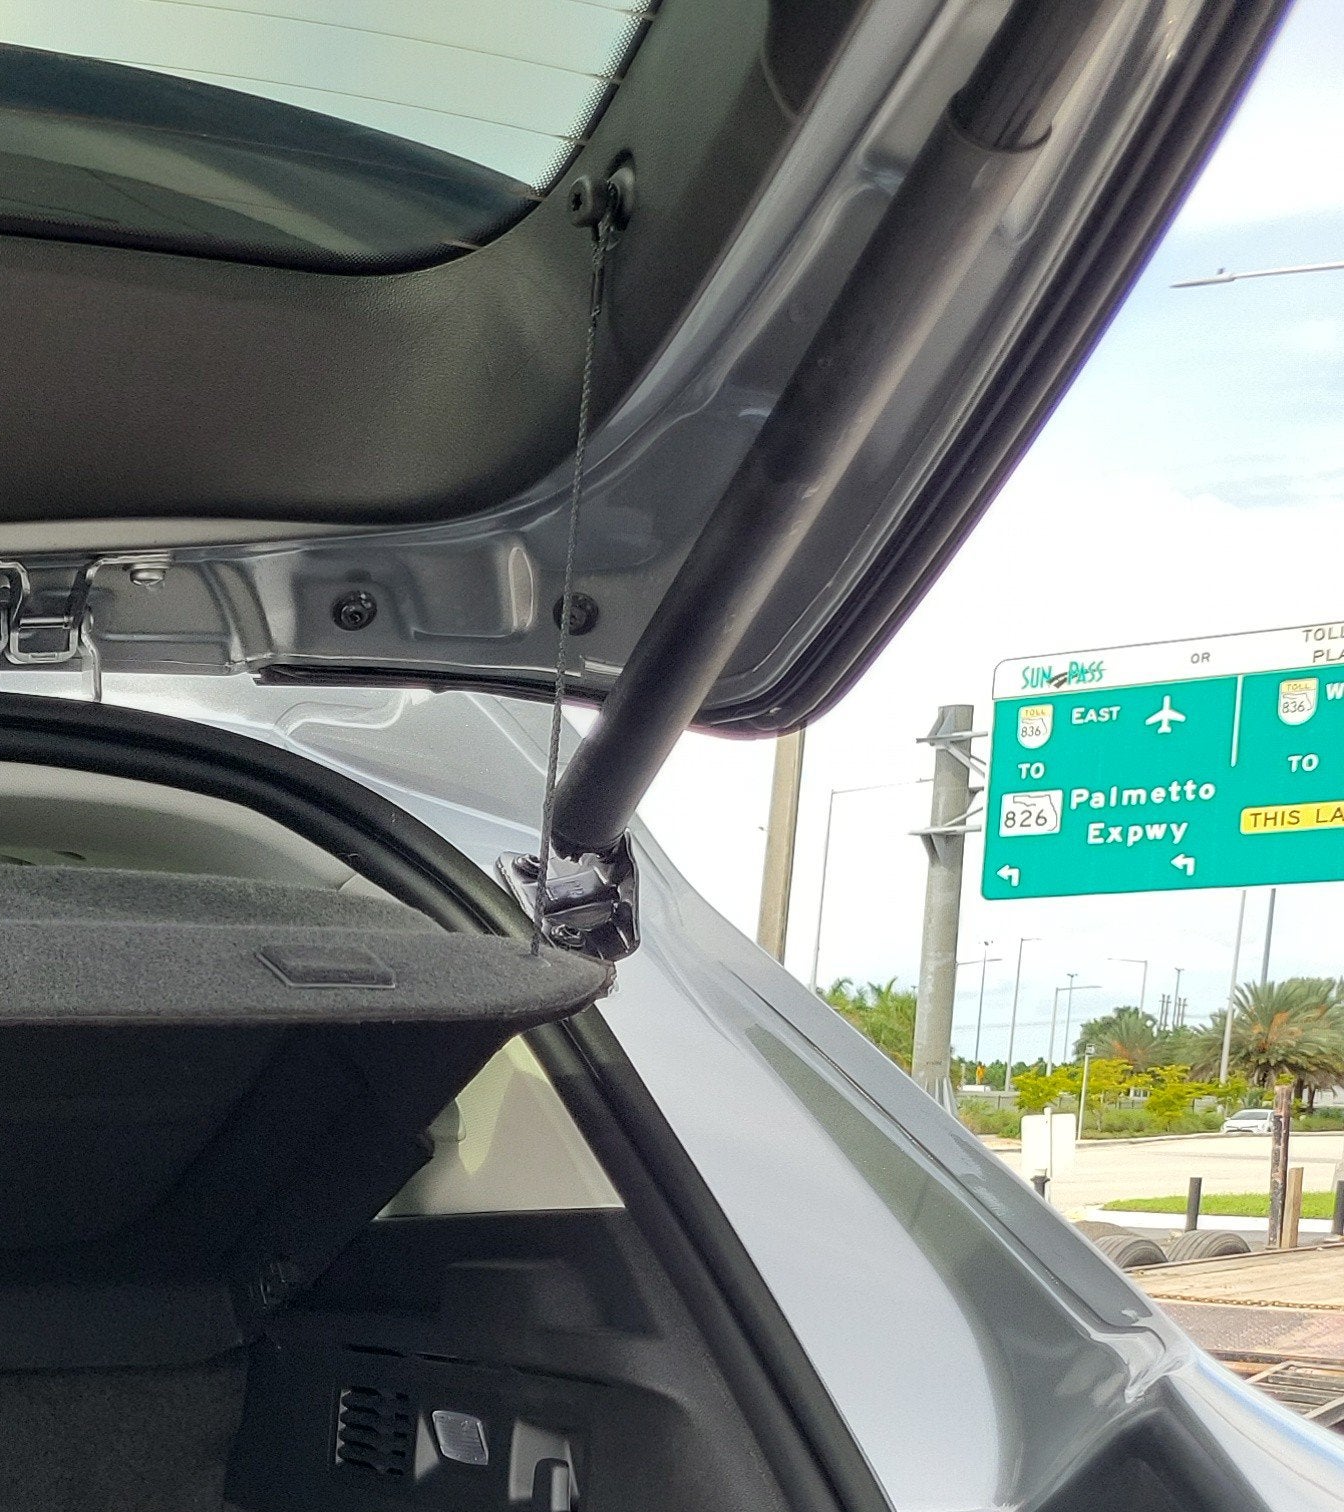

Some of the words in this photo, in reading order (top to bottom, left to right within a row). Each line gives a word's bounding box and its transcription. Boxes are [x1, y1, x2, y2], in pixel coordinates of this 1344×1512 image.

[1191, 652, 1211, 664] OR
[1071, 706, 1121, 724] EAST
[1282, 701, 1305, 713] 836
[1021, 726, 1041, 737] 836
[1017, 762, 1045, 779] TO
[1287, 753, 1319, 772] TO
[1070, 780, 1216, 810] Palmetto
[1004, 809, 1047, 828] 826
[1250, 809, 1300, 828] THIS
[1087, 822, 1188, 847] Expwy
